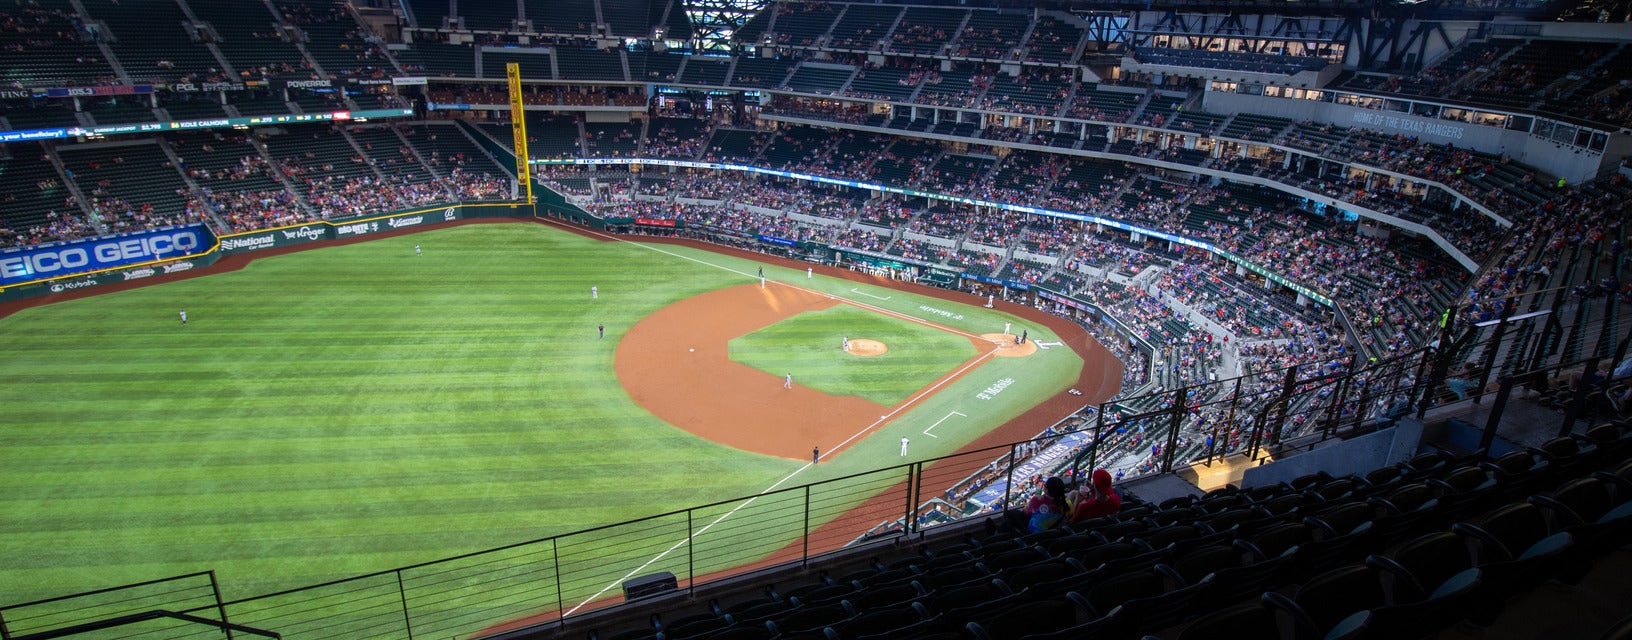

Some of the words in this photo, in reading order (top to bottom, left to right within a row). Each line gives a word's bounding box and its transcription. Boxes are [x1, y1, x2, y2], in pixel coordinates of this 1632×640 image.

[176, 83, 197, 92] PGL
[287, 80, 332, 88] POWERADE
[67, 87, 93, 96] 105.3
[198, 119, 229, 127] CALHOUN
[1353, 111, 1373, 124] HOME
[1373, 114, 1385, 126] OF
[1385, 116, 1399, 129] THE
[1399, 118, 1425, 133] TEXAS
[1425, 122, 1464, 139] RANGERS
[21, 130, 63, 138] beneficiary?
[297, 226, 325, 240] Kroger
[338, 225, 352, 235] BIG
[352, 223, 369, 232] BITE
[233, 234, 274, 248] National
[0, 248, 89, 278] EICO
[94, 232, 197, 263] GEICO
[65, 280, 97, 289] Kubota
[983, 377, 1016, 396] Mobile
[1031, 443, 1069, 470] RANGERS
